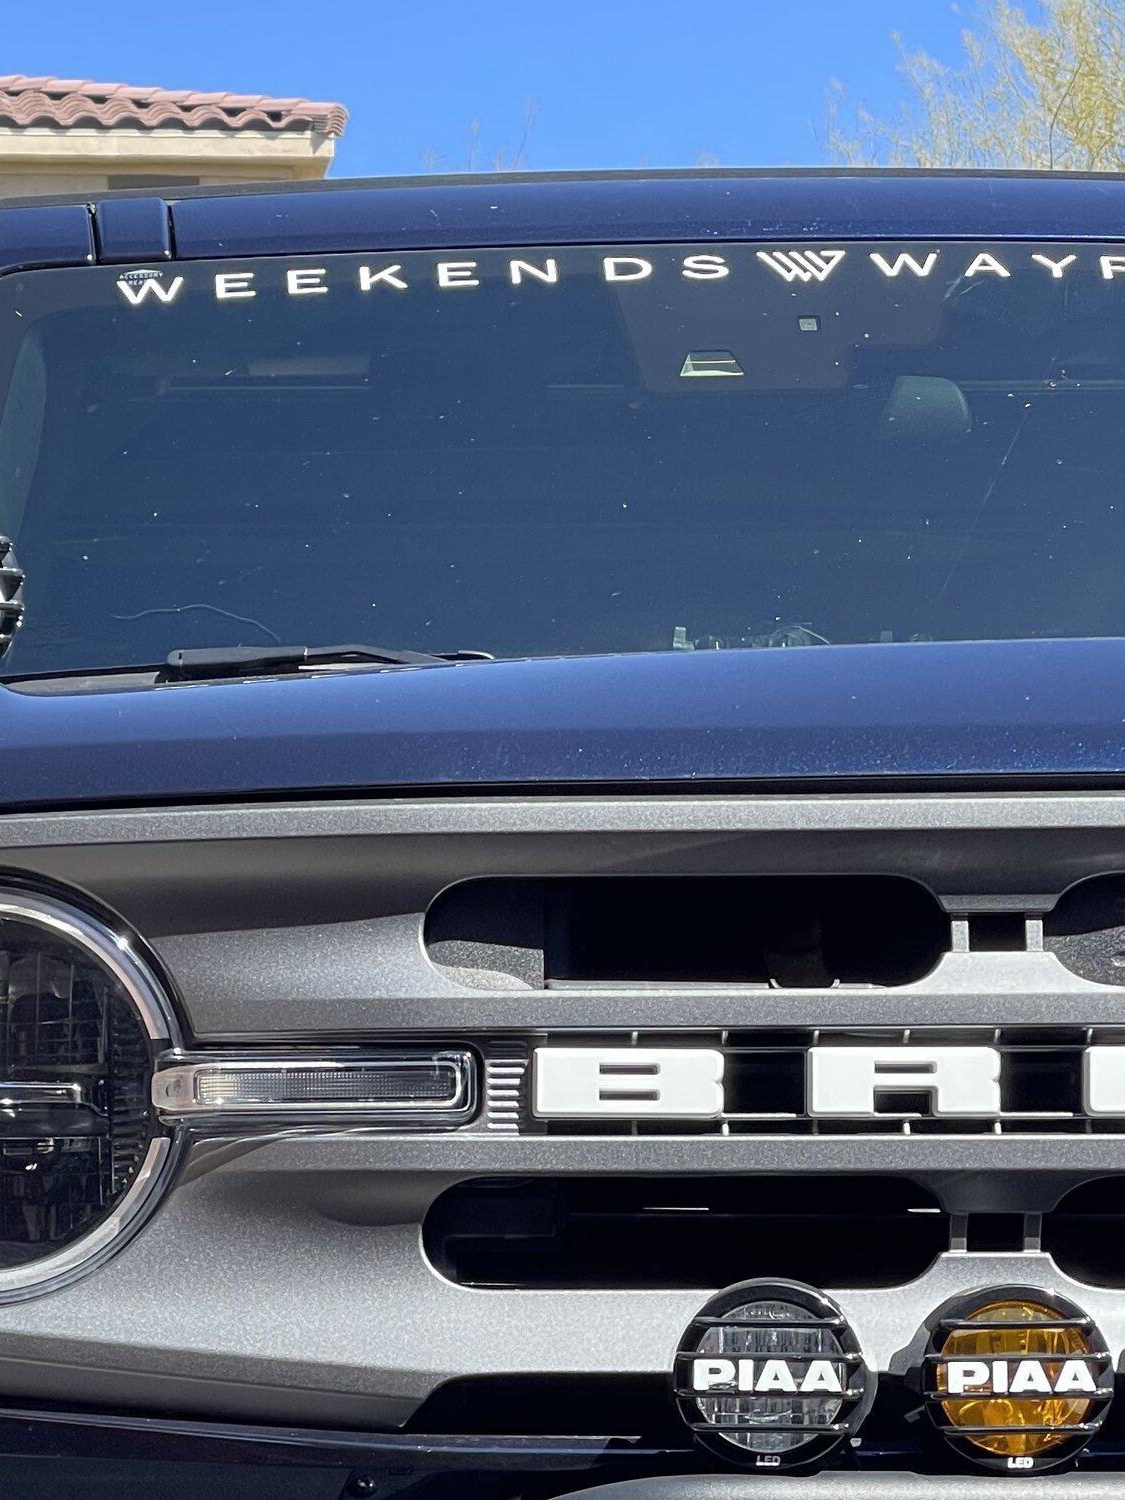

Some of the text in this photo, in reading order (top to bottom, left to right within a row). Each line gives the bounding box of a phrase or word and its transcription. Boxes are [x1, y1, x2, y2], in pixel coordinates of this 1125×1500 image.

[116, 254, 730, 304] WEEKENDS
[532, 1047, 1125, 1119] BR
[693, 1359, 843, 1393] PIAA
[947, 1359, 1097, 1393] PIAA
[755, 1455, 781, 1467] LED
[1007, 1457, 1034, 1469] LED
